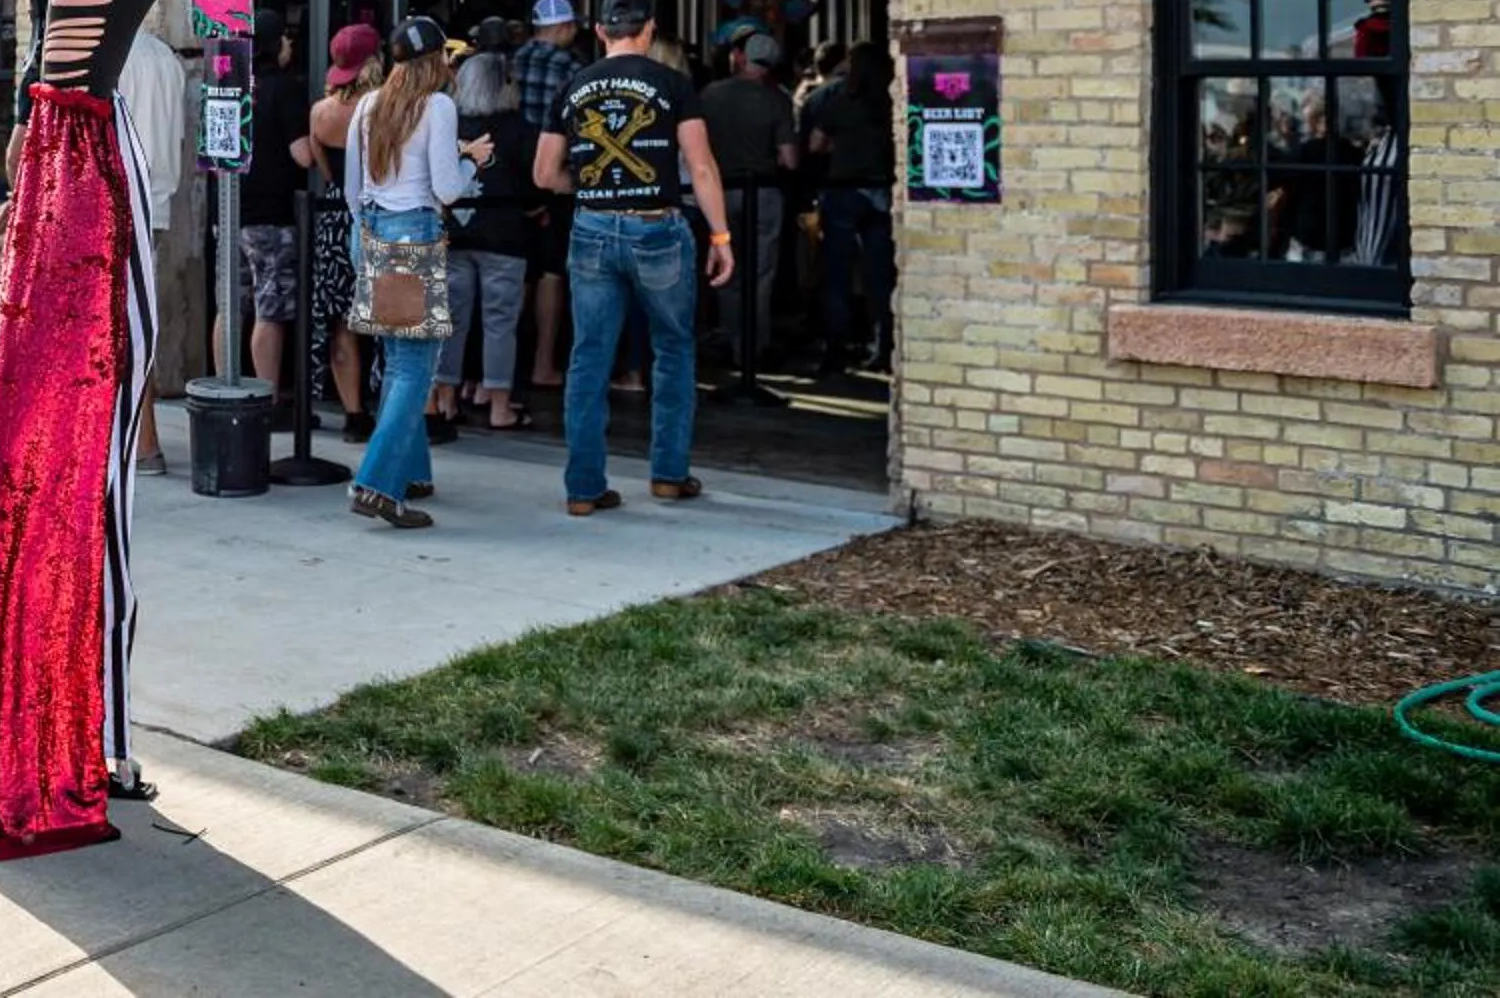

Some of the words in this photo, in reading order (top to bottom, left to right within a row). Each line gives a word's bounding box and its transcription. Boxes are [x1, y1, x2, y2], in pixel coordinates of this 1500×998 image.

[569, 78, 609, 104] DIRTY
[610, 77, 657, 99] HANDS
[577, 189, 613, 200] CLEAN
[617, 185, 661, 198] MONEY
